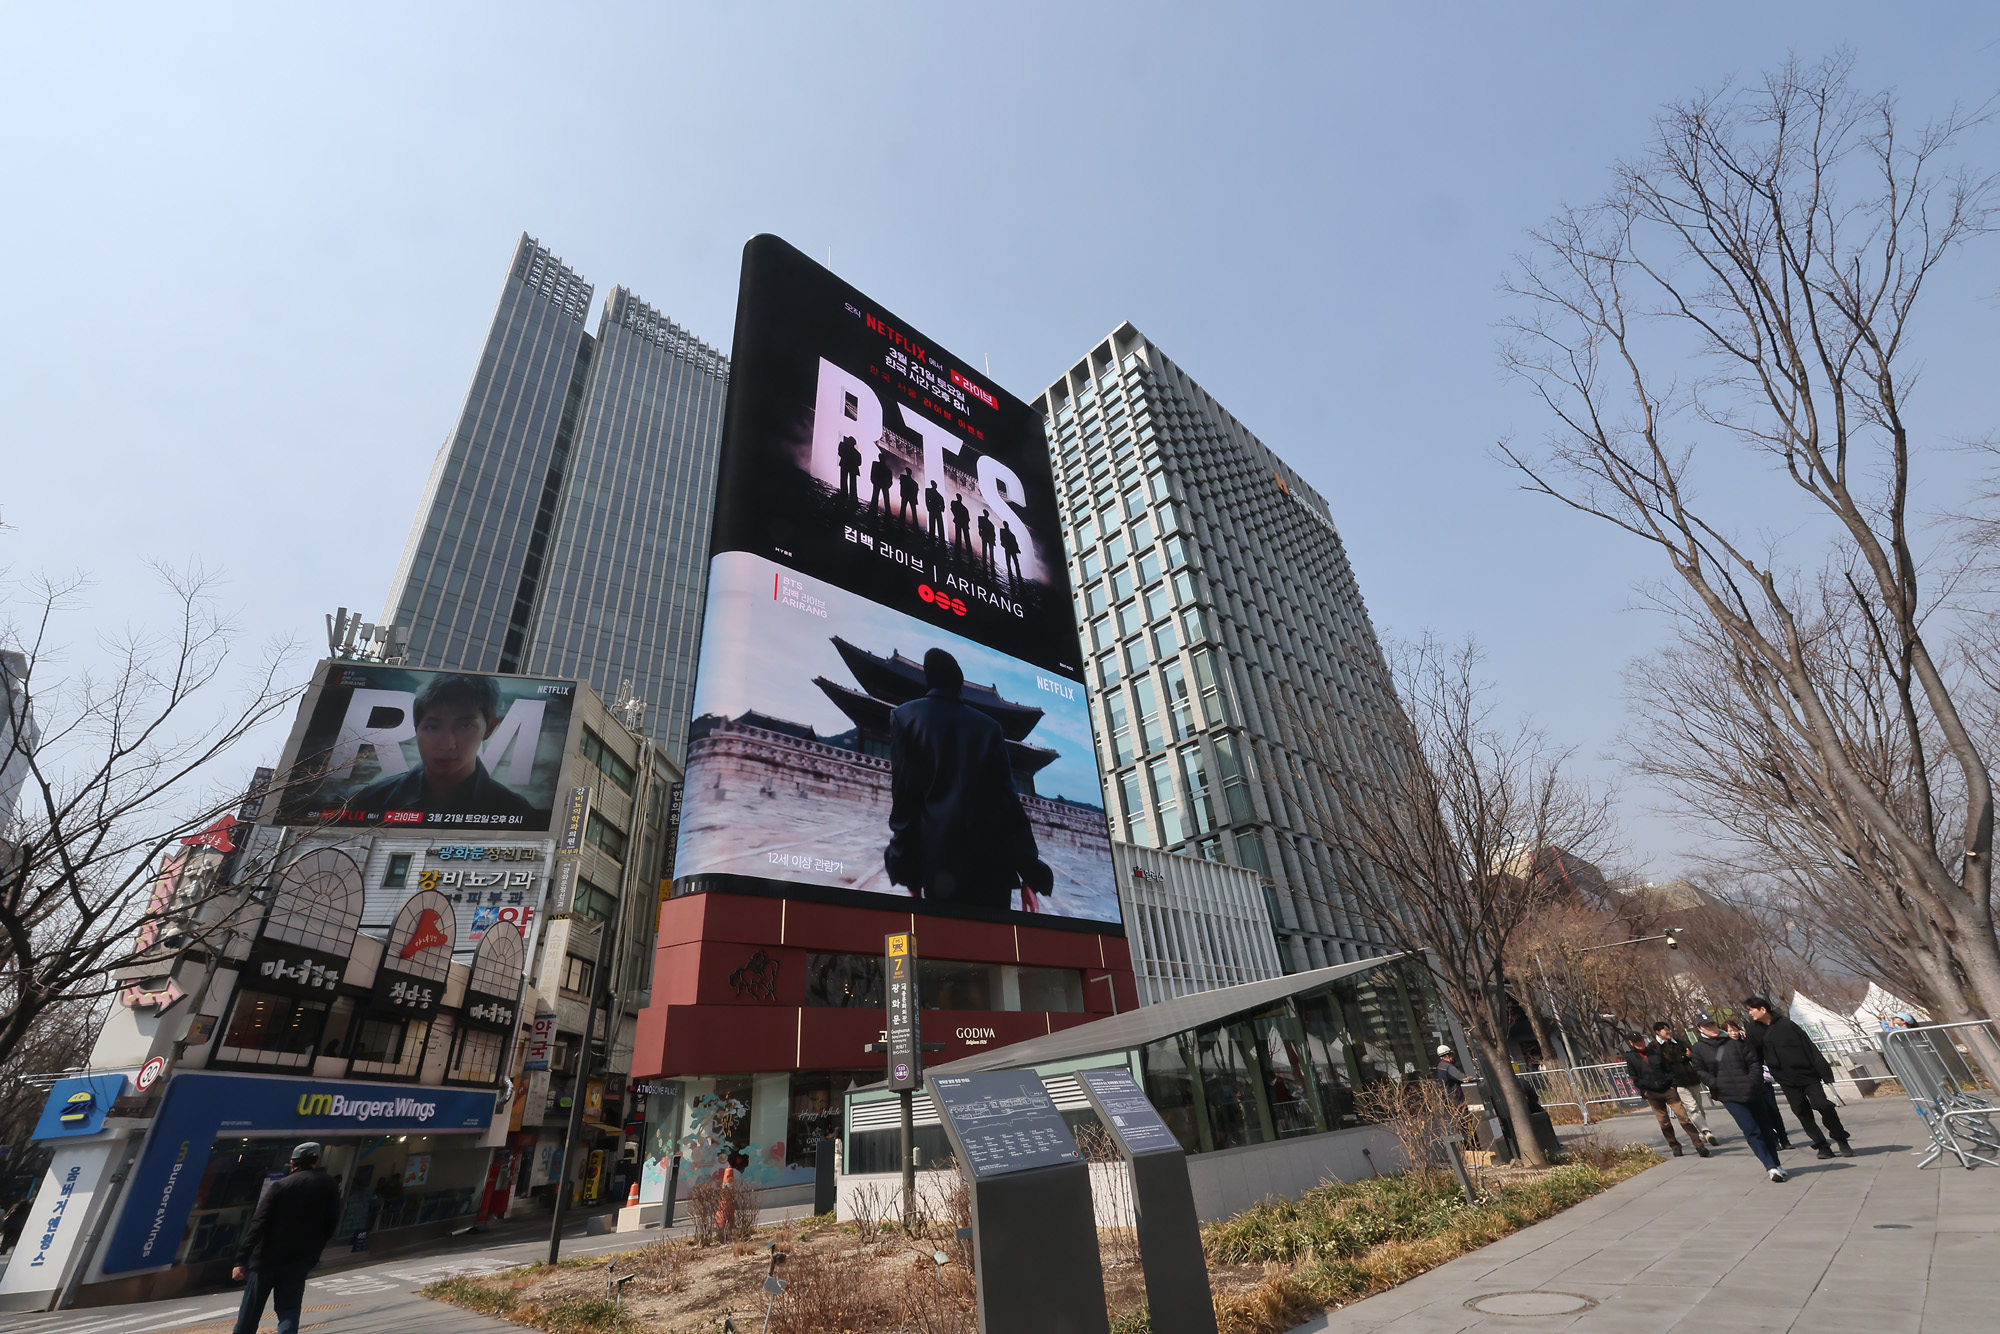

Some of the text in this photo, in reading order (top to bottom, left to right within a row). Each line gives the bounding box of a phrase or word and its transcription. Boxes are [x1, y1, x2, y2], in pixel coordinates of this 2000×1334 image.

[866, 312, 926, 363] NETFLIX
[962, 378, 993, 405] 라이브
[885, 355, 970, 416] 한국 시간 오후 8시
[889, 347, 966, 402] 3월 21일 토요일
[869, 365, 985, 440] 한국 서울 라이브 이벤트
[783, 576, 803, 590] BTS
[844, 525, 1024, 618] 컴백 라이브 ARIRANG
[781, 596, 828, 619] ARIRANG
[782, 586, 826, 609] 컴백 라이브
[537, 684, 570, 696] NETFLIX
[1036, 675, 1075, 702] NETFLIX
[321, 809, 366, 821] NETFLIX
[394, 812, 420, 822] 라이브
[427, 813, 443, 823] 3월
[444, 814, 463, 823] 21일
[465, 814, 489, 824] 토요일
[490, 815, 507, 824] 오후
[508, 815, 523, 824] 8시
[418, 870, 536, 891] 강비뇨기과
[466, 891, 524, 905] 피부과
[260, 959, 339, 990] 마녀김밥
[894, 958, 903, 971] 7
[389, 981, 432, 1009] 청담동
[891, 983, 901, 1025] 광화문
[469, 1003, 513, 1025] 마녀김밥
[531, 1019, 552, 1059] 약국
[956, 1027, 996, 1039] GODIVA
[143, 1064, 158, 1083] 30
